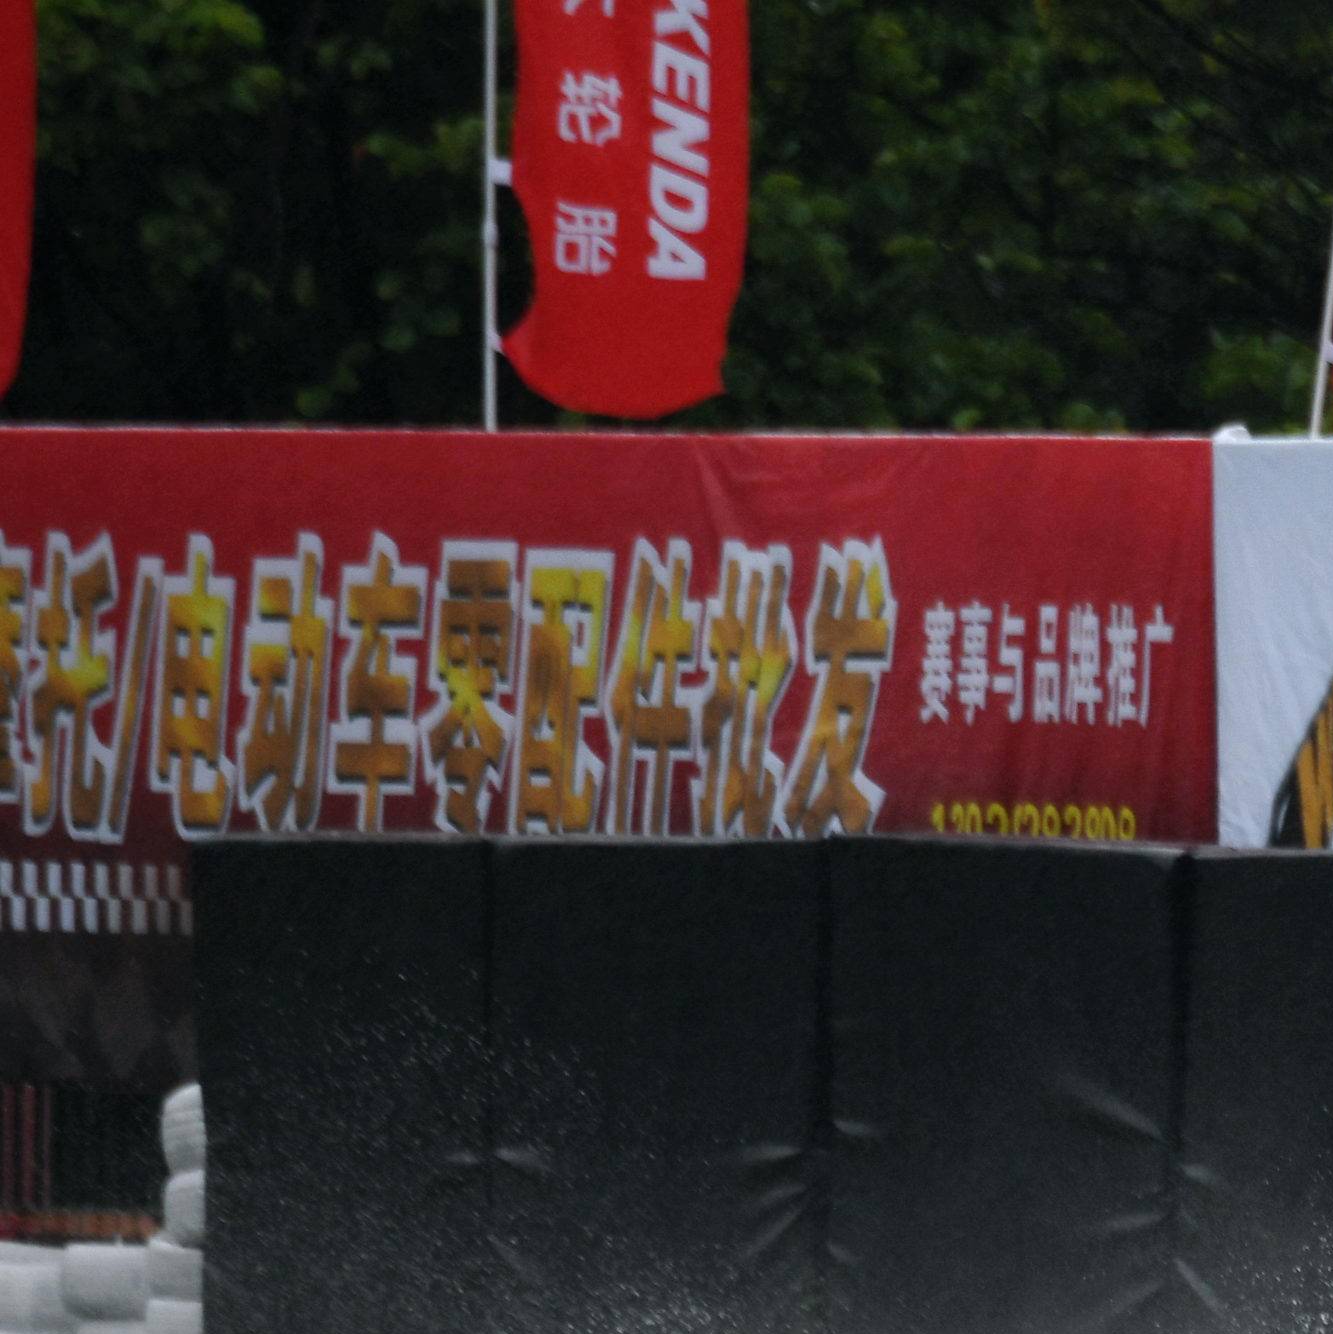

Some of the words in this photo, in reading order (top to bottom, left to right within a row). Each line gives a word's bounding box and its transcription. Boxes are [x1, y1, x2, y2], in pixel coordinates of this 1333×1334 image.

[646, 0, 712, 281] KENDA
[0, 529, 897, 843] 托/电动车零配件批发
